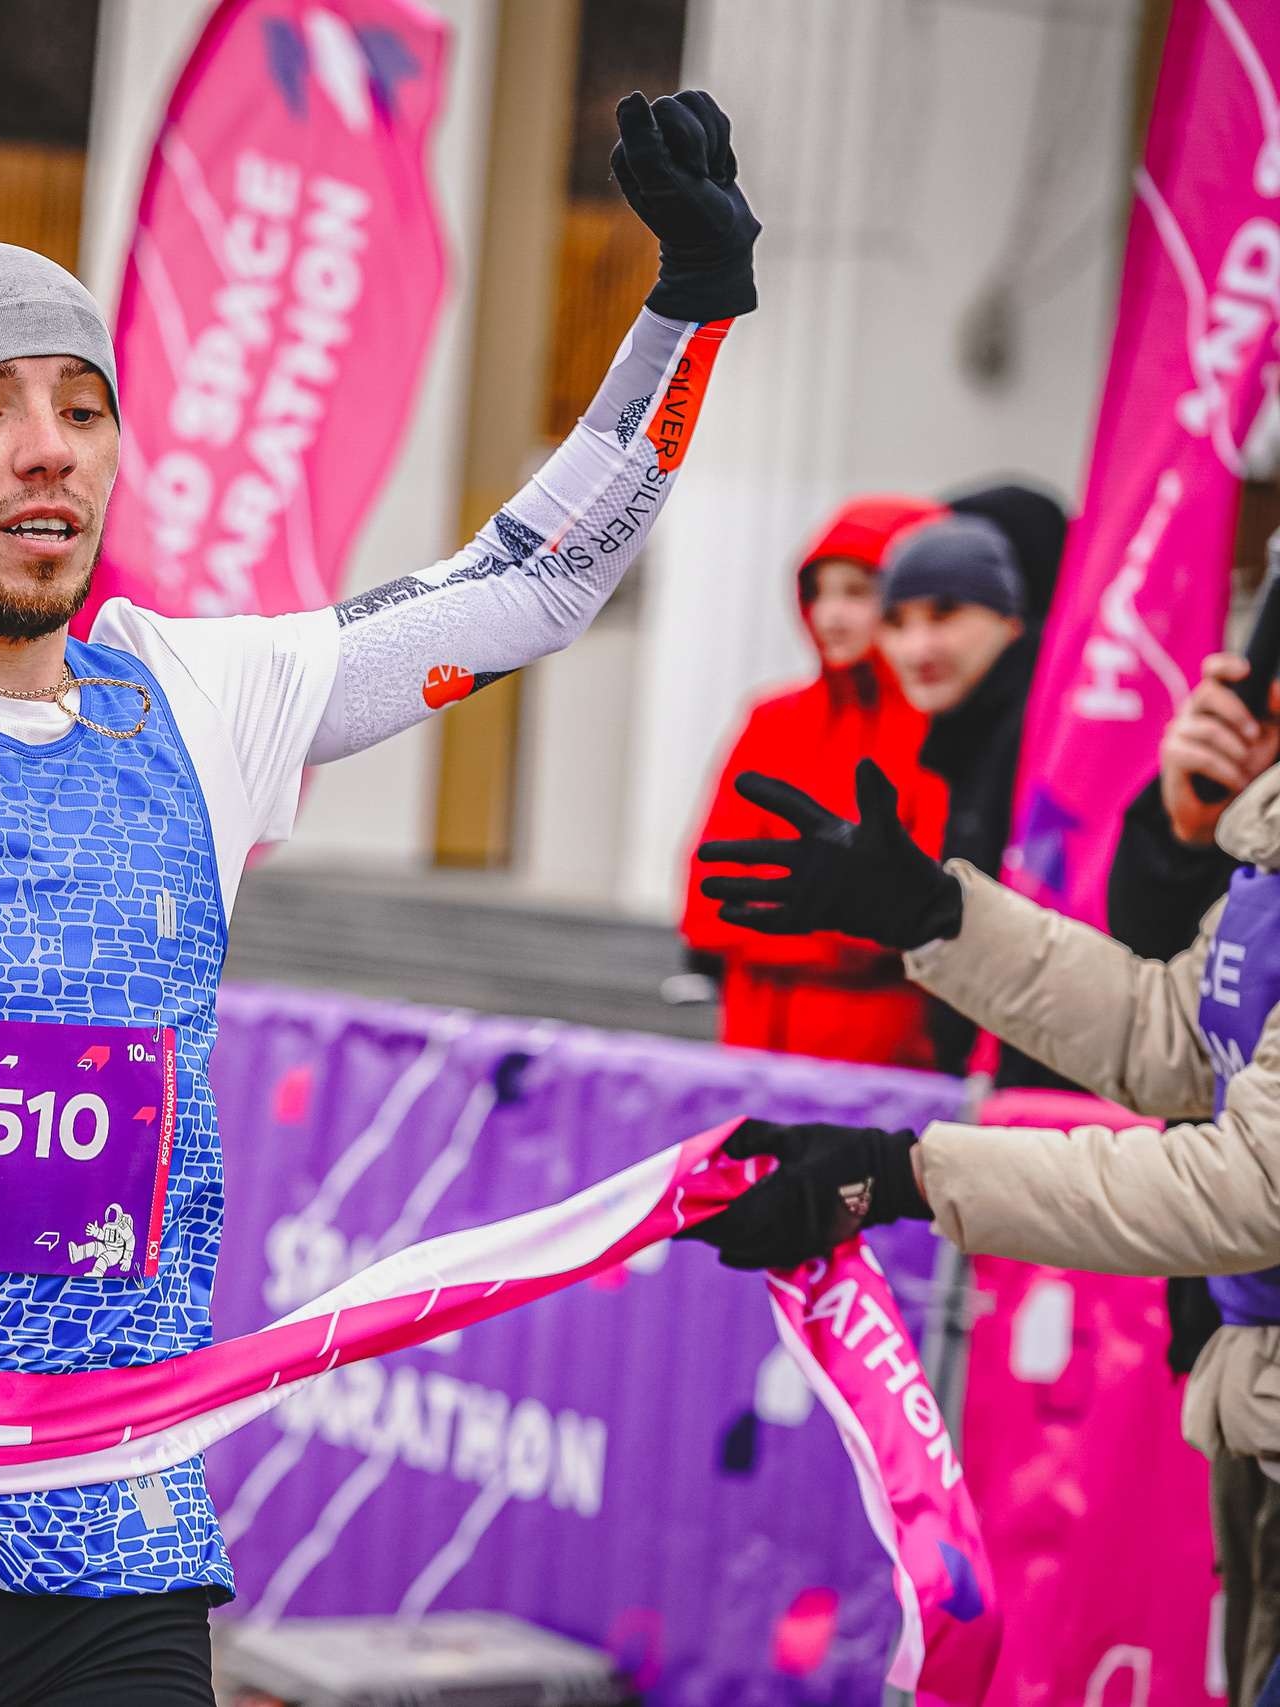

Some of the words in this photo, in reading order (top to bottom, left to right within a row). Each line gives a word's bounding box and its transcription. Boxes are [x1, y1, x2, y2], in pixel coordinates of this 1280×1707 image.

[656, 358, 691, 458] SILVER
[589, 465, 668, 554] SILVER
[160, 1049, 174, 1166] #SPACEMARATHON
